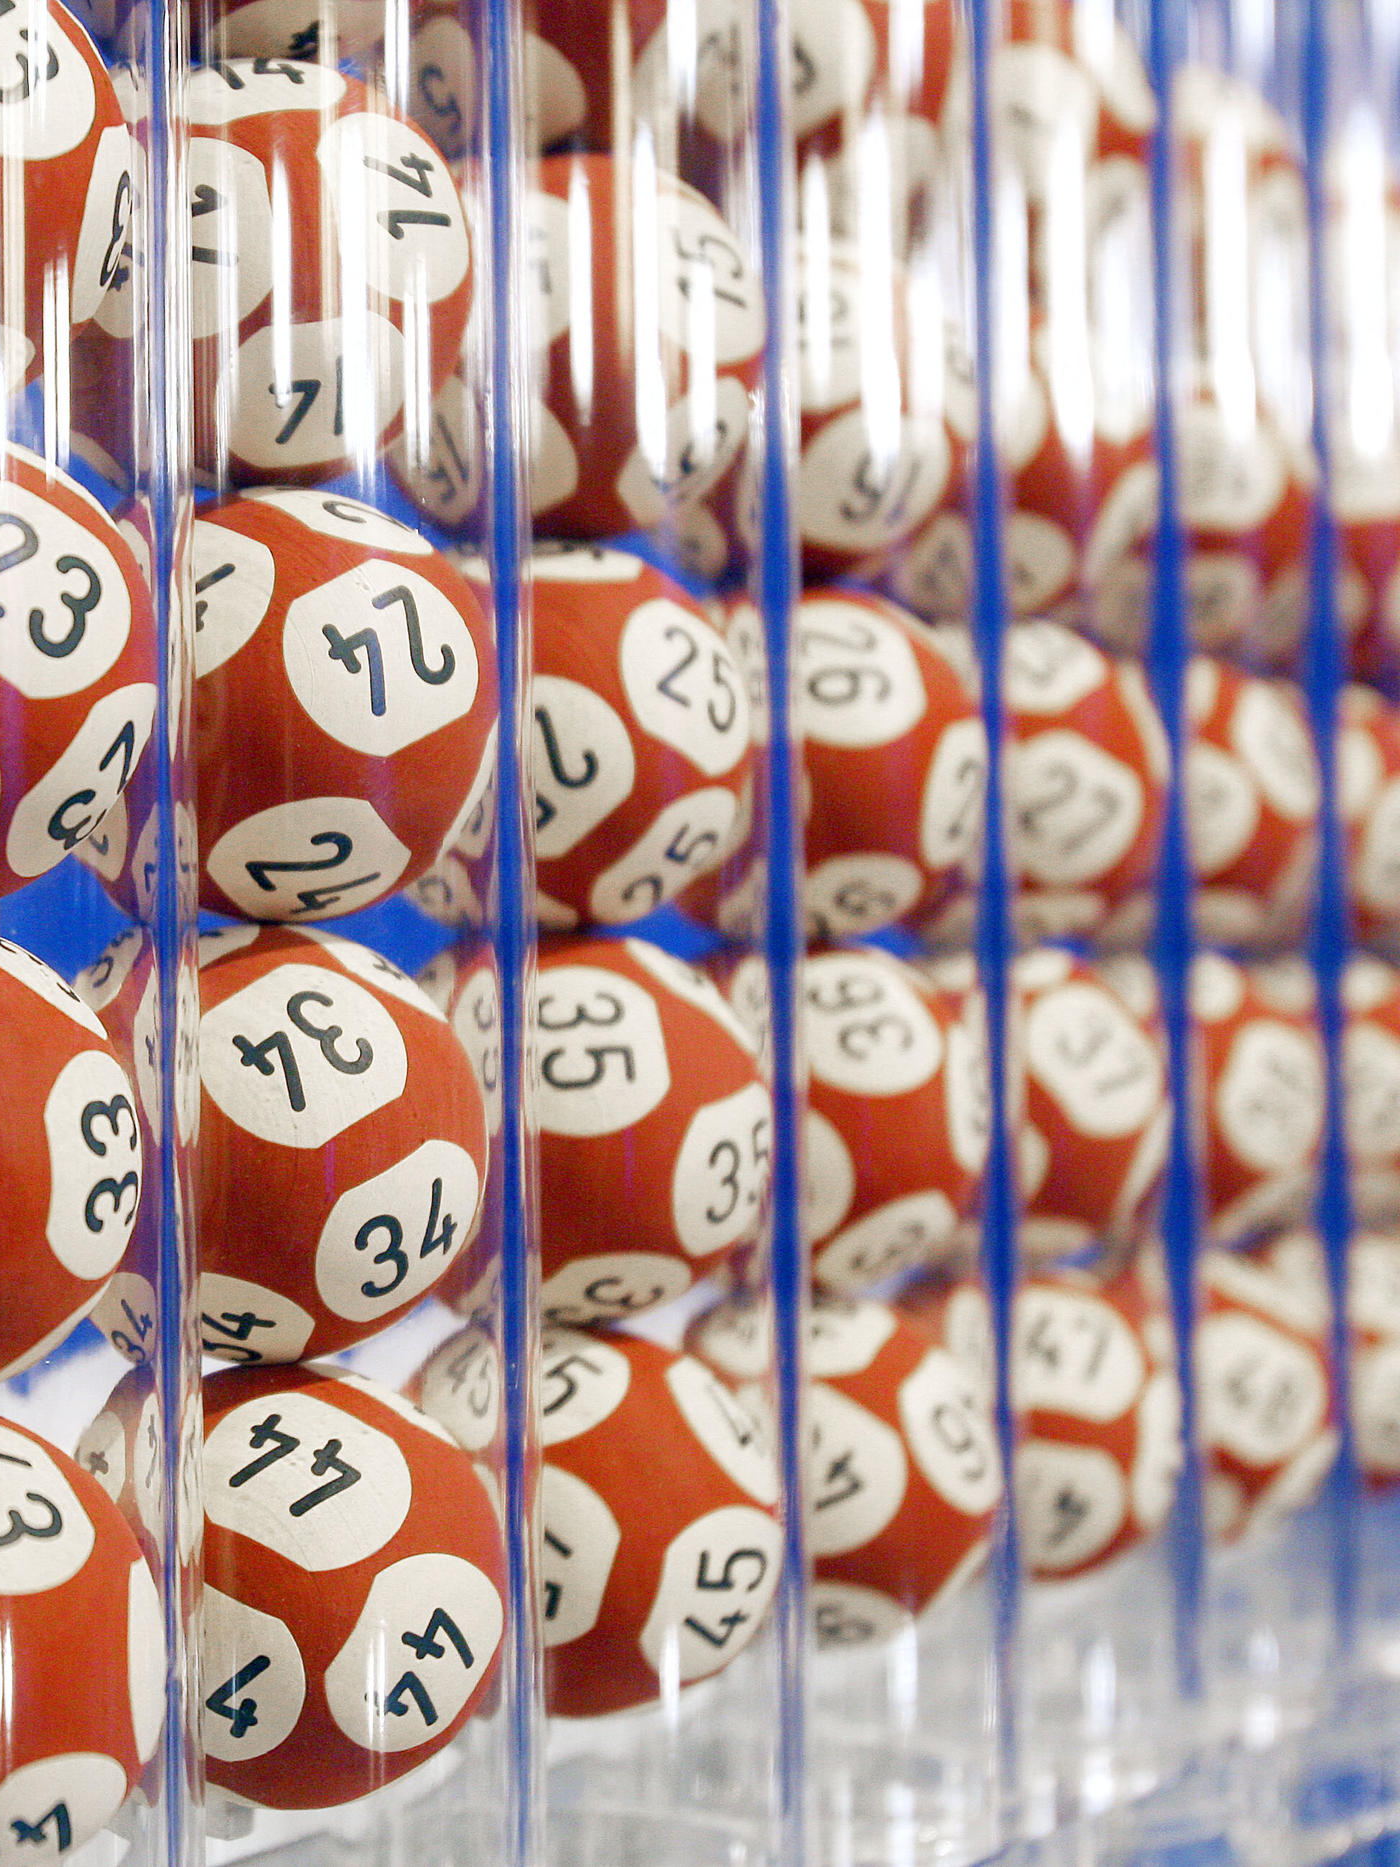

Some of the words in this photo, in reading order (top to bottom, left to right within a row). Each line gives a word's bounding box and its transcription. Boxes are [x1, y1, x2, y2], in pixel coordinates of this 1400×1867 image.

[363, 152, 452, 241] 14
[305, 585, 457, 718] 24
[656, 624, 738, 734] 25
[799, 622, 892, 707] 26
[244, 831, 383, 915] 24
[232, 991, 374, 1112] 34
[538, 993, 636, 1092] 35
[81, 1094, 139, 1233] 33
[355, 1177, 459, 1298] 34
[228, 1413, 363, 1518] 44
[684, 1547, 768, 1649] 45
[364, 1607, 475, 1728] 44
